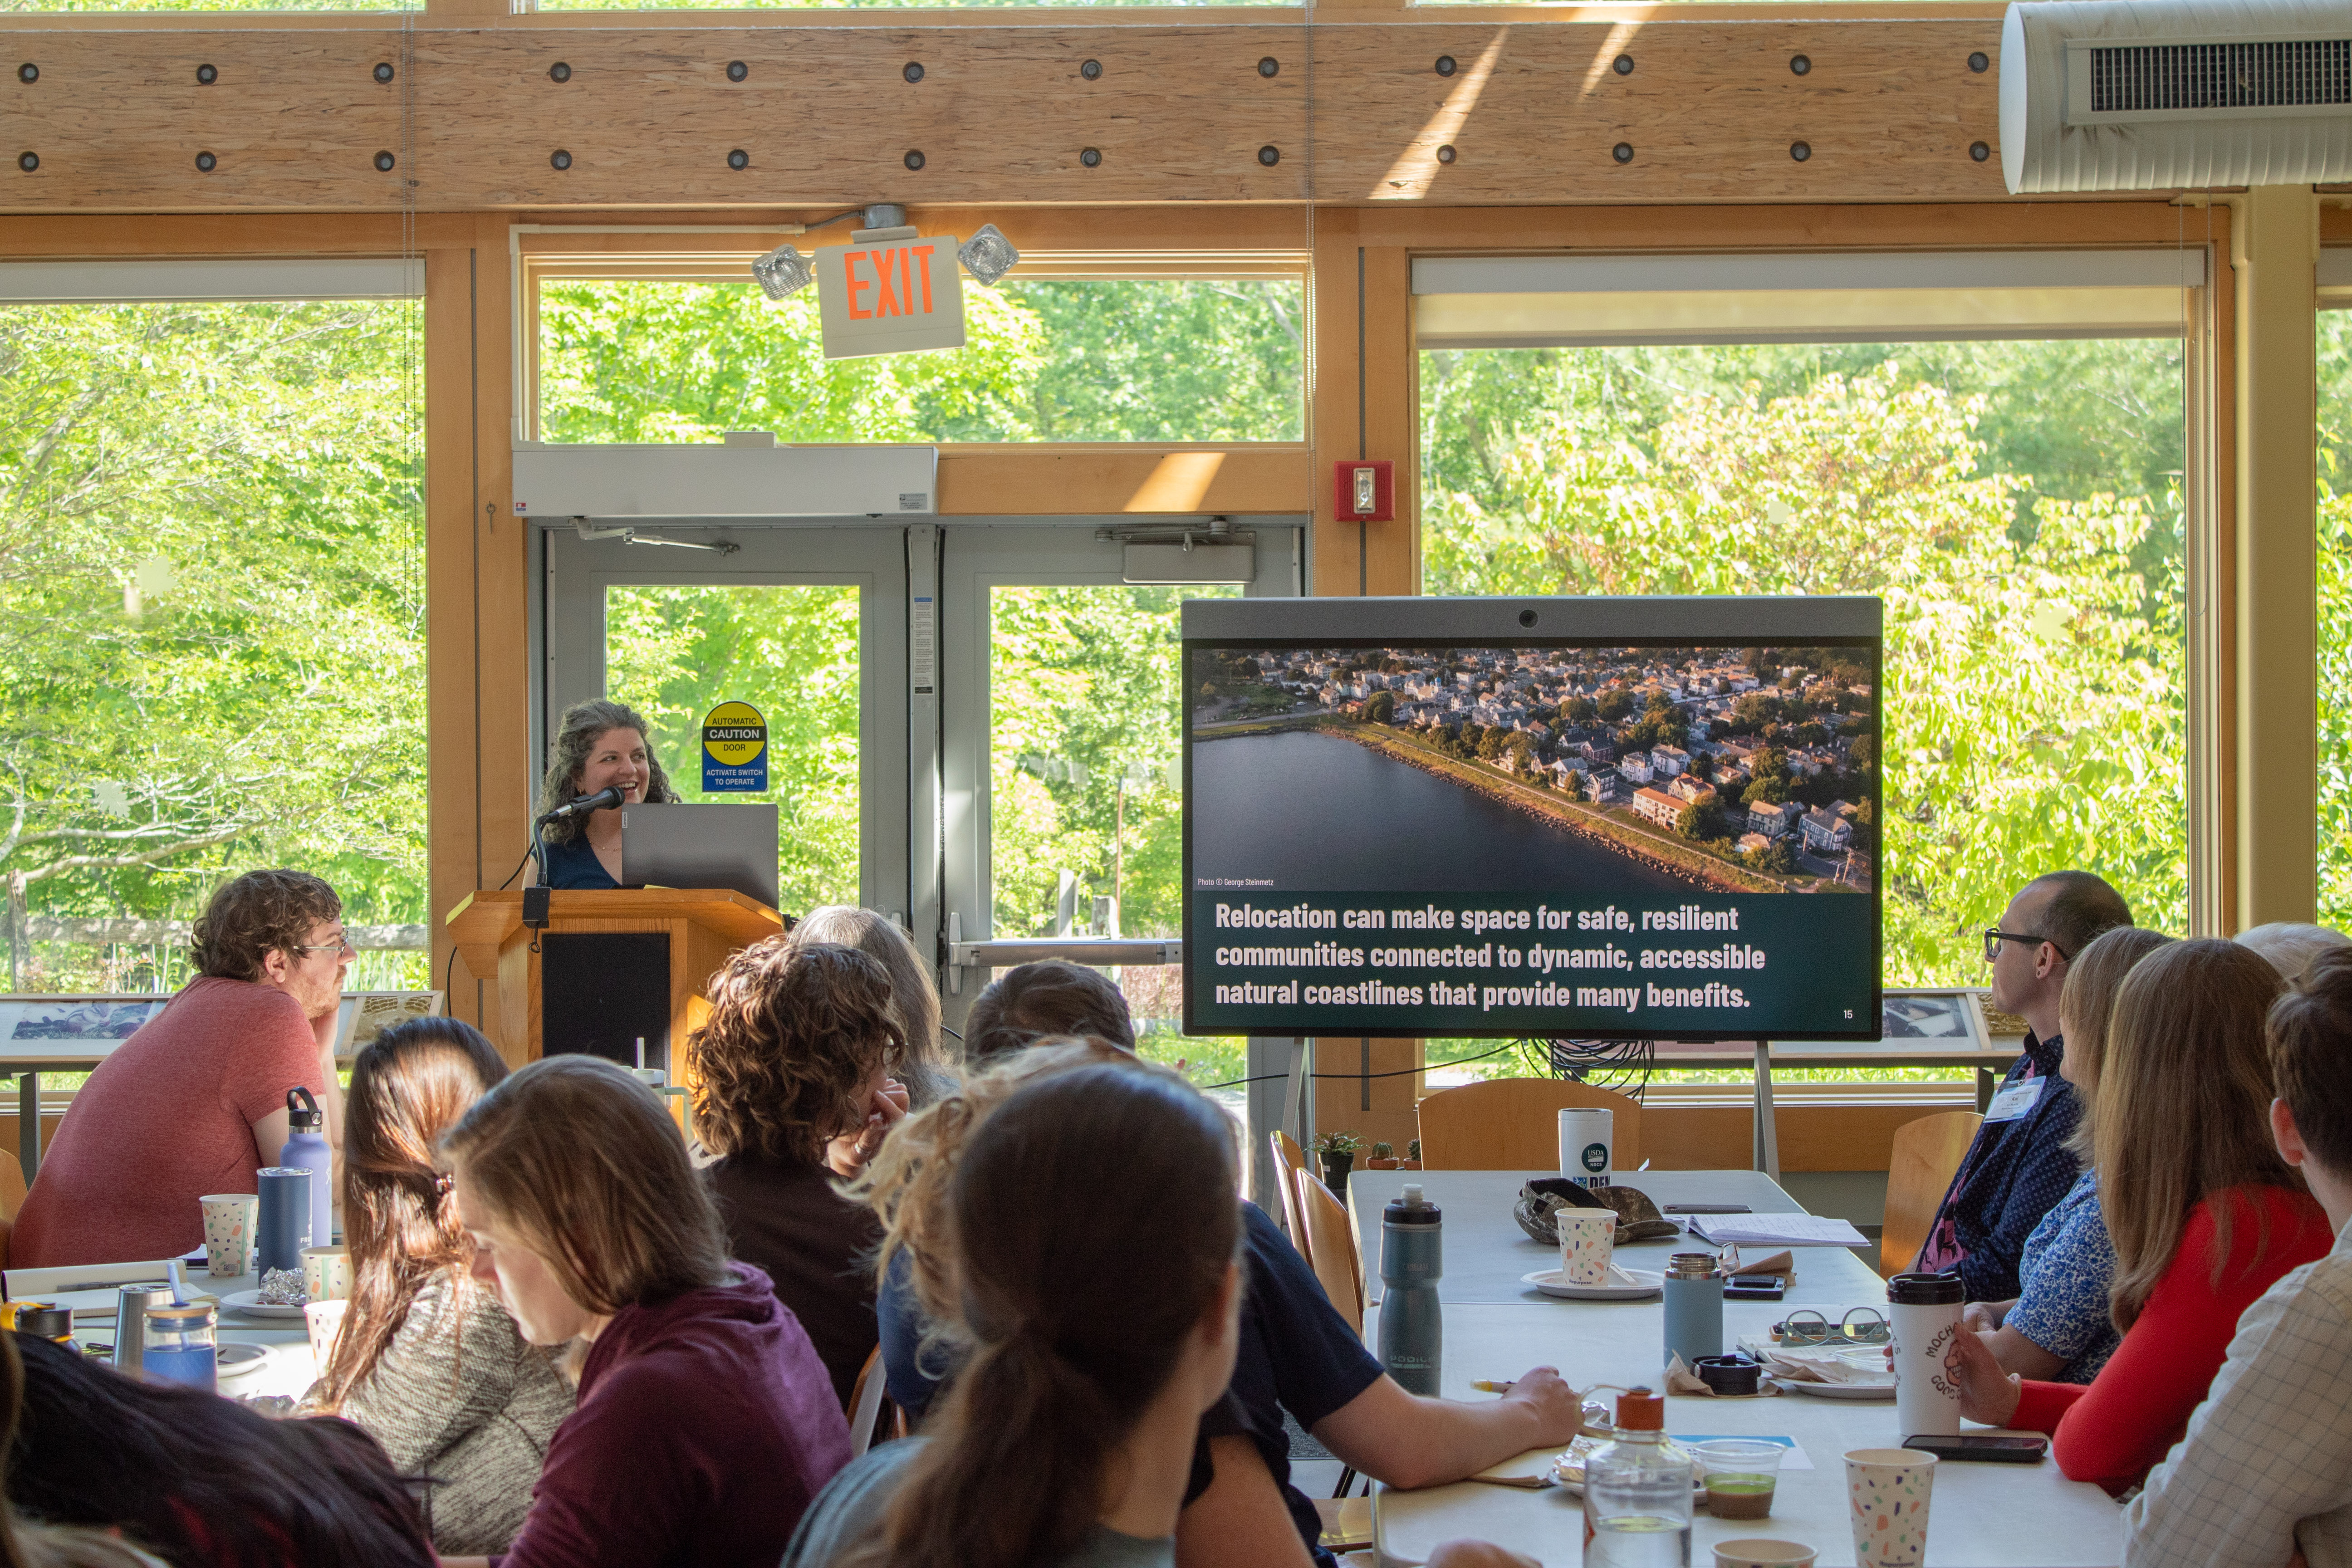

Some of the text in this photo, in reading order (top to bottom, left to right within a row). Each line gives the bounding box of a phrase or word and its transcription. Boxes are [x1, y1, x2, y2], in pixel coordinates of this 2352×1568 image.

[844, 245, 934, 320] EXIT
[709, 729, 760, 739] CAUTION
[1224, 878, 1244, 887] George
[1245, 878, 1274, 886] Steinmetz
[1216, 903, 1739, 935] Relocation can make space for safe, resilient
[1215, 941, 1765, 974] communities connected to dynamic, accessible
[1216, 980, 1750, 1013] natural coastlines that provide many benefits.
[1843, 1009, 1853, 1019] 15
